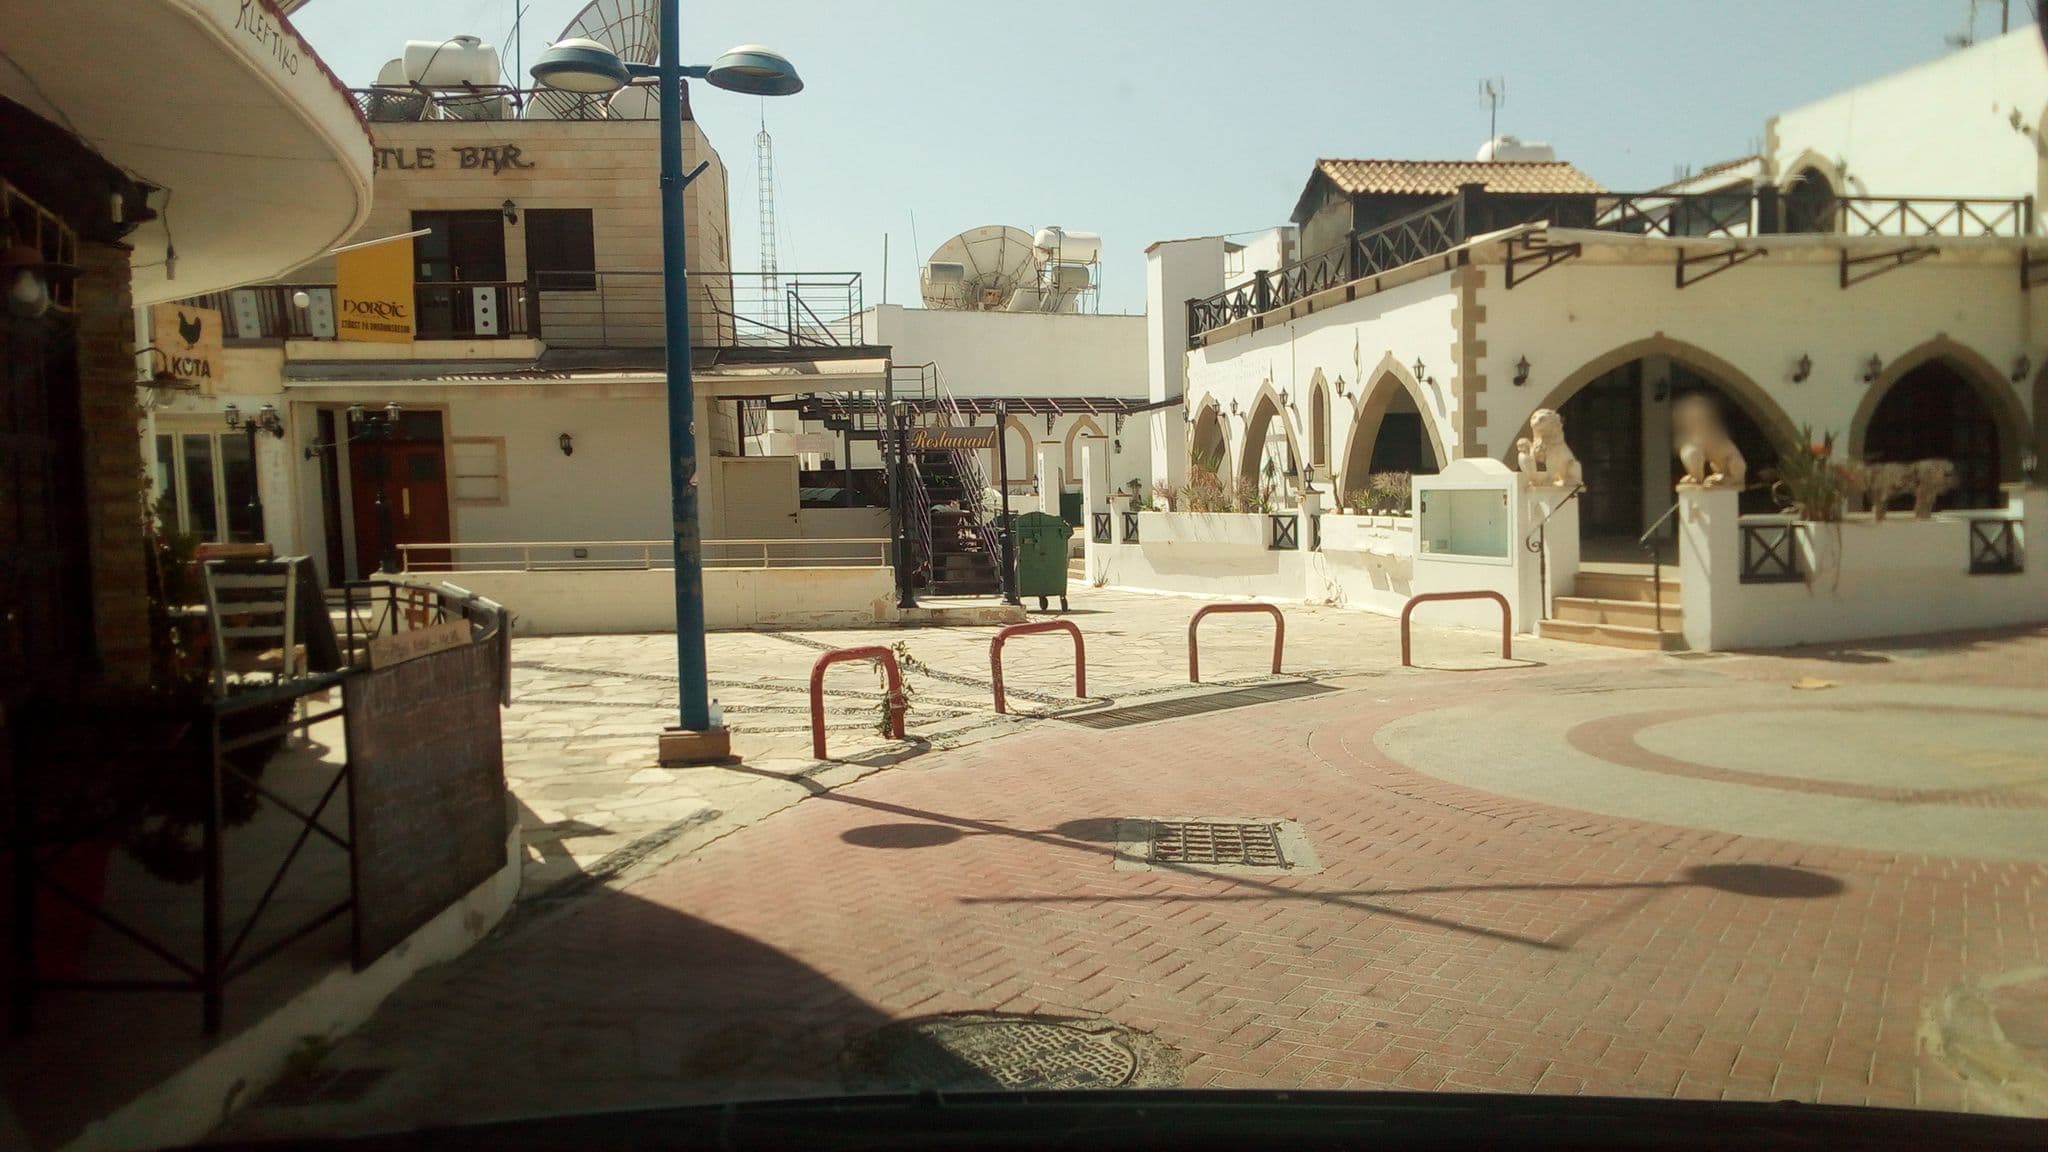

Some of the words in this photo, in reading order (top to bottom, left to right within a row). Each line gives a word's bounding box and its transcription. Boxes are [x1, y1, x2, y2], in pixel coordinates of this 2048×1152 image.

[235, 0, 298, 75] KLEFTIKO
[374, 147, 435, 169] TLE
[452, 144, 535, 176] BAR
[172, 357, 211, 378] KOTA
[911, 429, 995, 448] Restaurant
